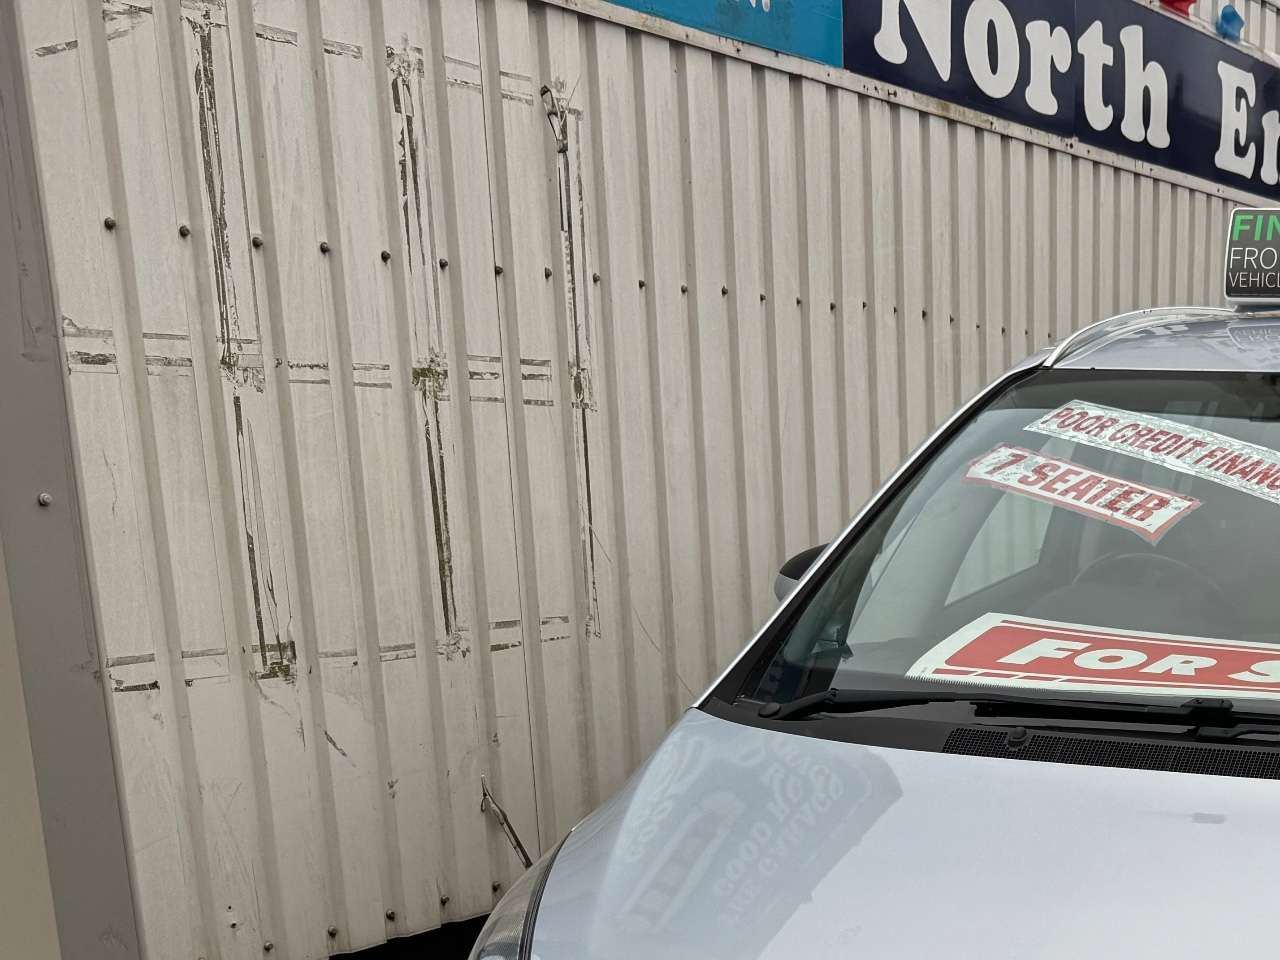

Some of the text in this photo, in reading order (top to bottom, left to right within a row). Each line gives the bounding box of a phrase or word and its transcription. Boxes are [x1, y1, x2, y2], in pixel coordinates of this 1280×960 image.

[1040, 406, 1110, 438] POOR
[1108, 422, 1208, 461] CREDIT
[986, 453, 1172, 523] 7 SEATER
[997, 637, 1218, 676] FOR
